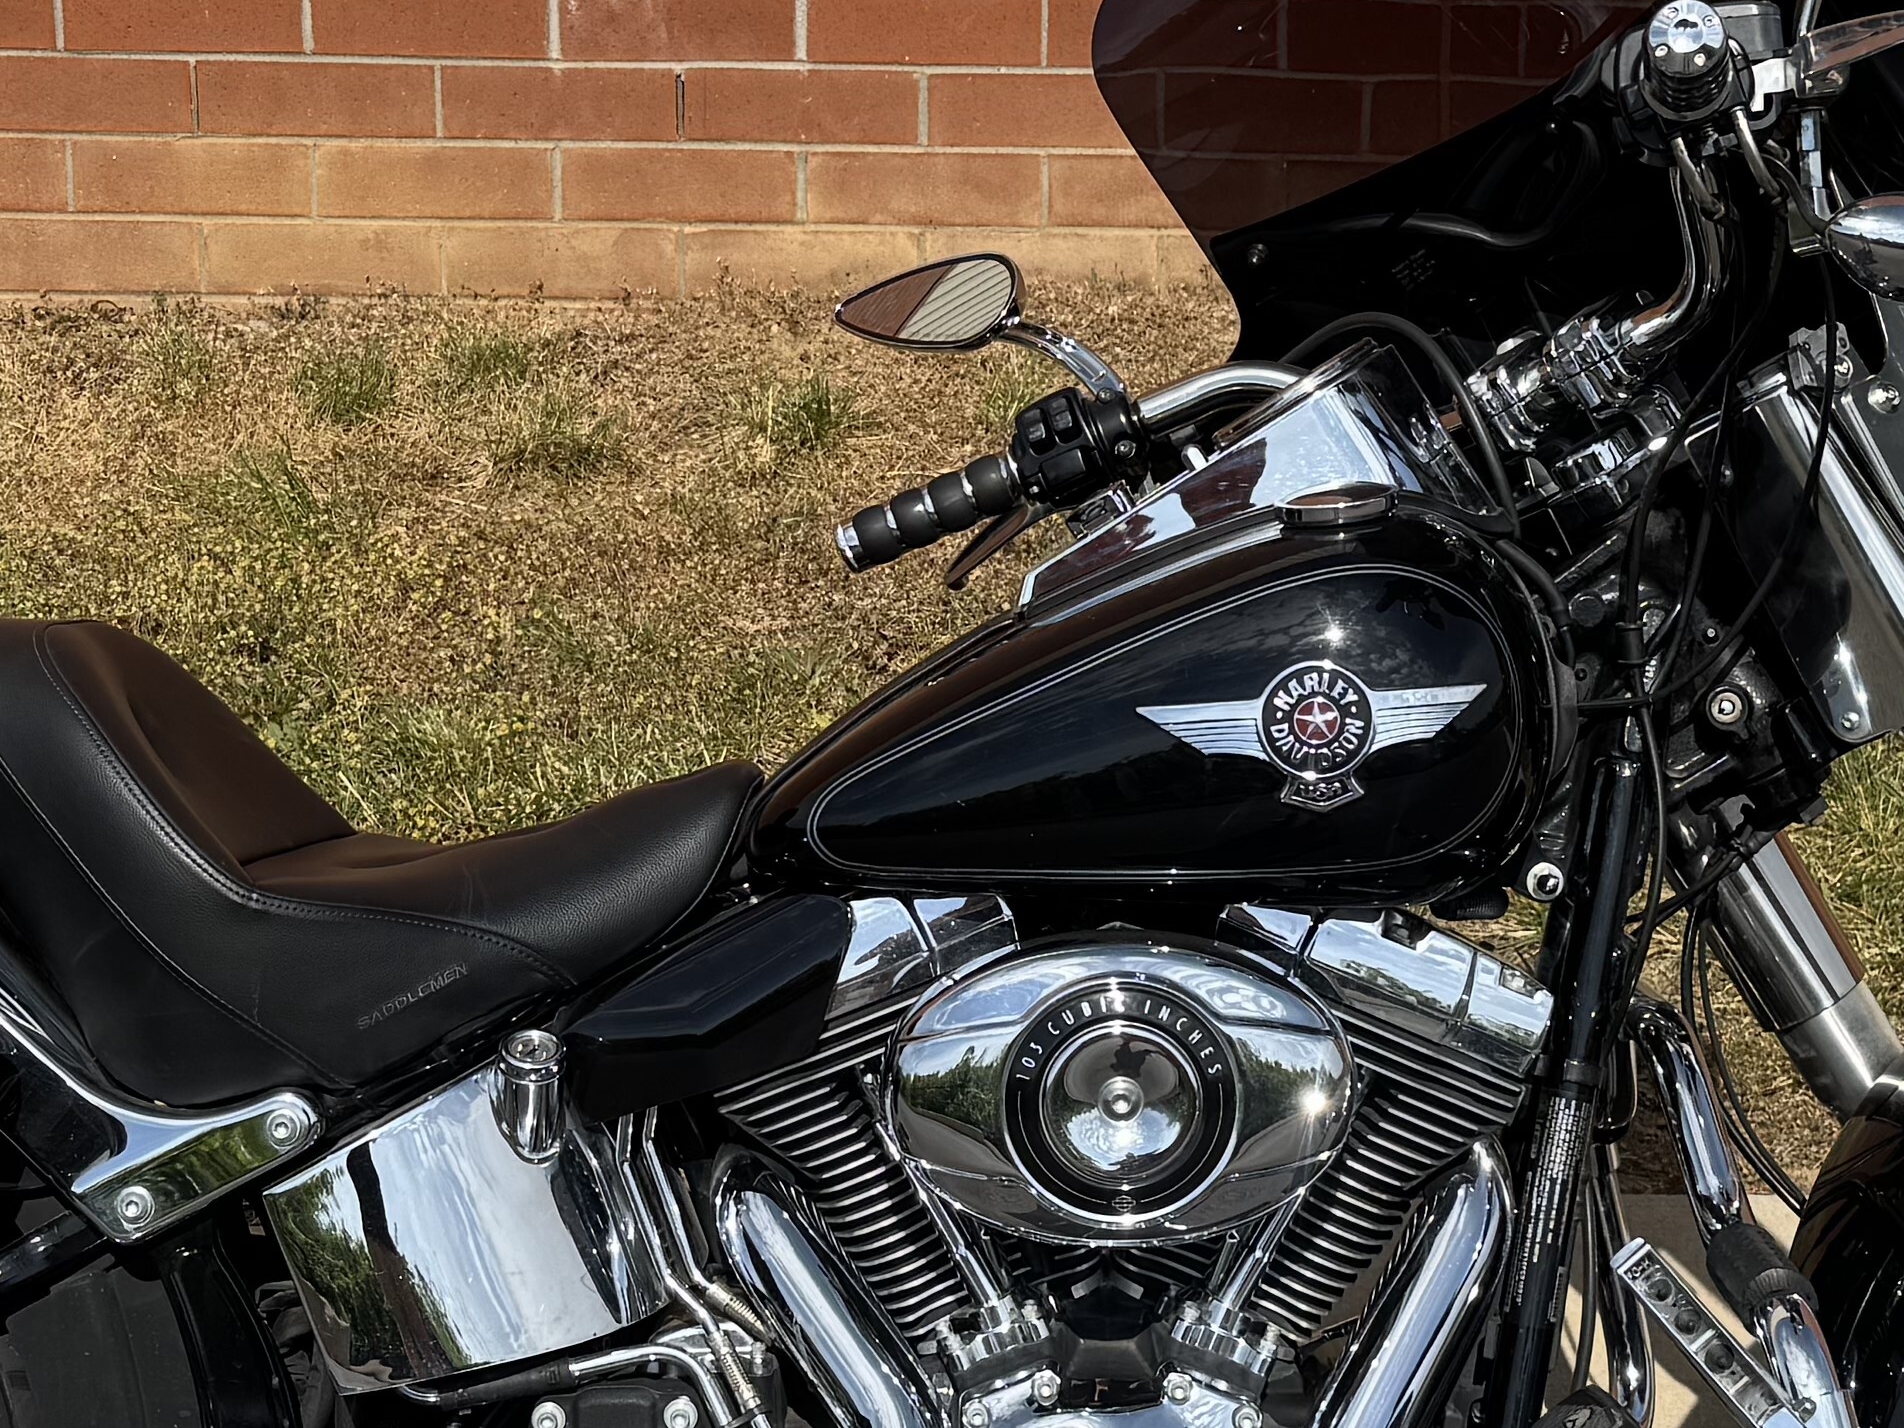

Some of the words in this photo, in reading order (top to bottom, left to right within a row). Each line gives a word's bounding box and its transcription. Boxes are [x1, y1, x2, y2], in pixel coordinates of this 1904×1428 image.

[1273, 672, 1359, 711] HARLEY
[1270, 718, 1364, 767] DAVIDSON
[357, 961, 468, 1029] SADDLEMEN
[1016, 1042, 1043, 1081] 103
[1048, 996, 1125, 1036] CUBIC
[1145, 1000, 1222, 1075] INCHES
